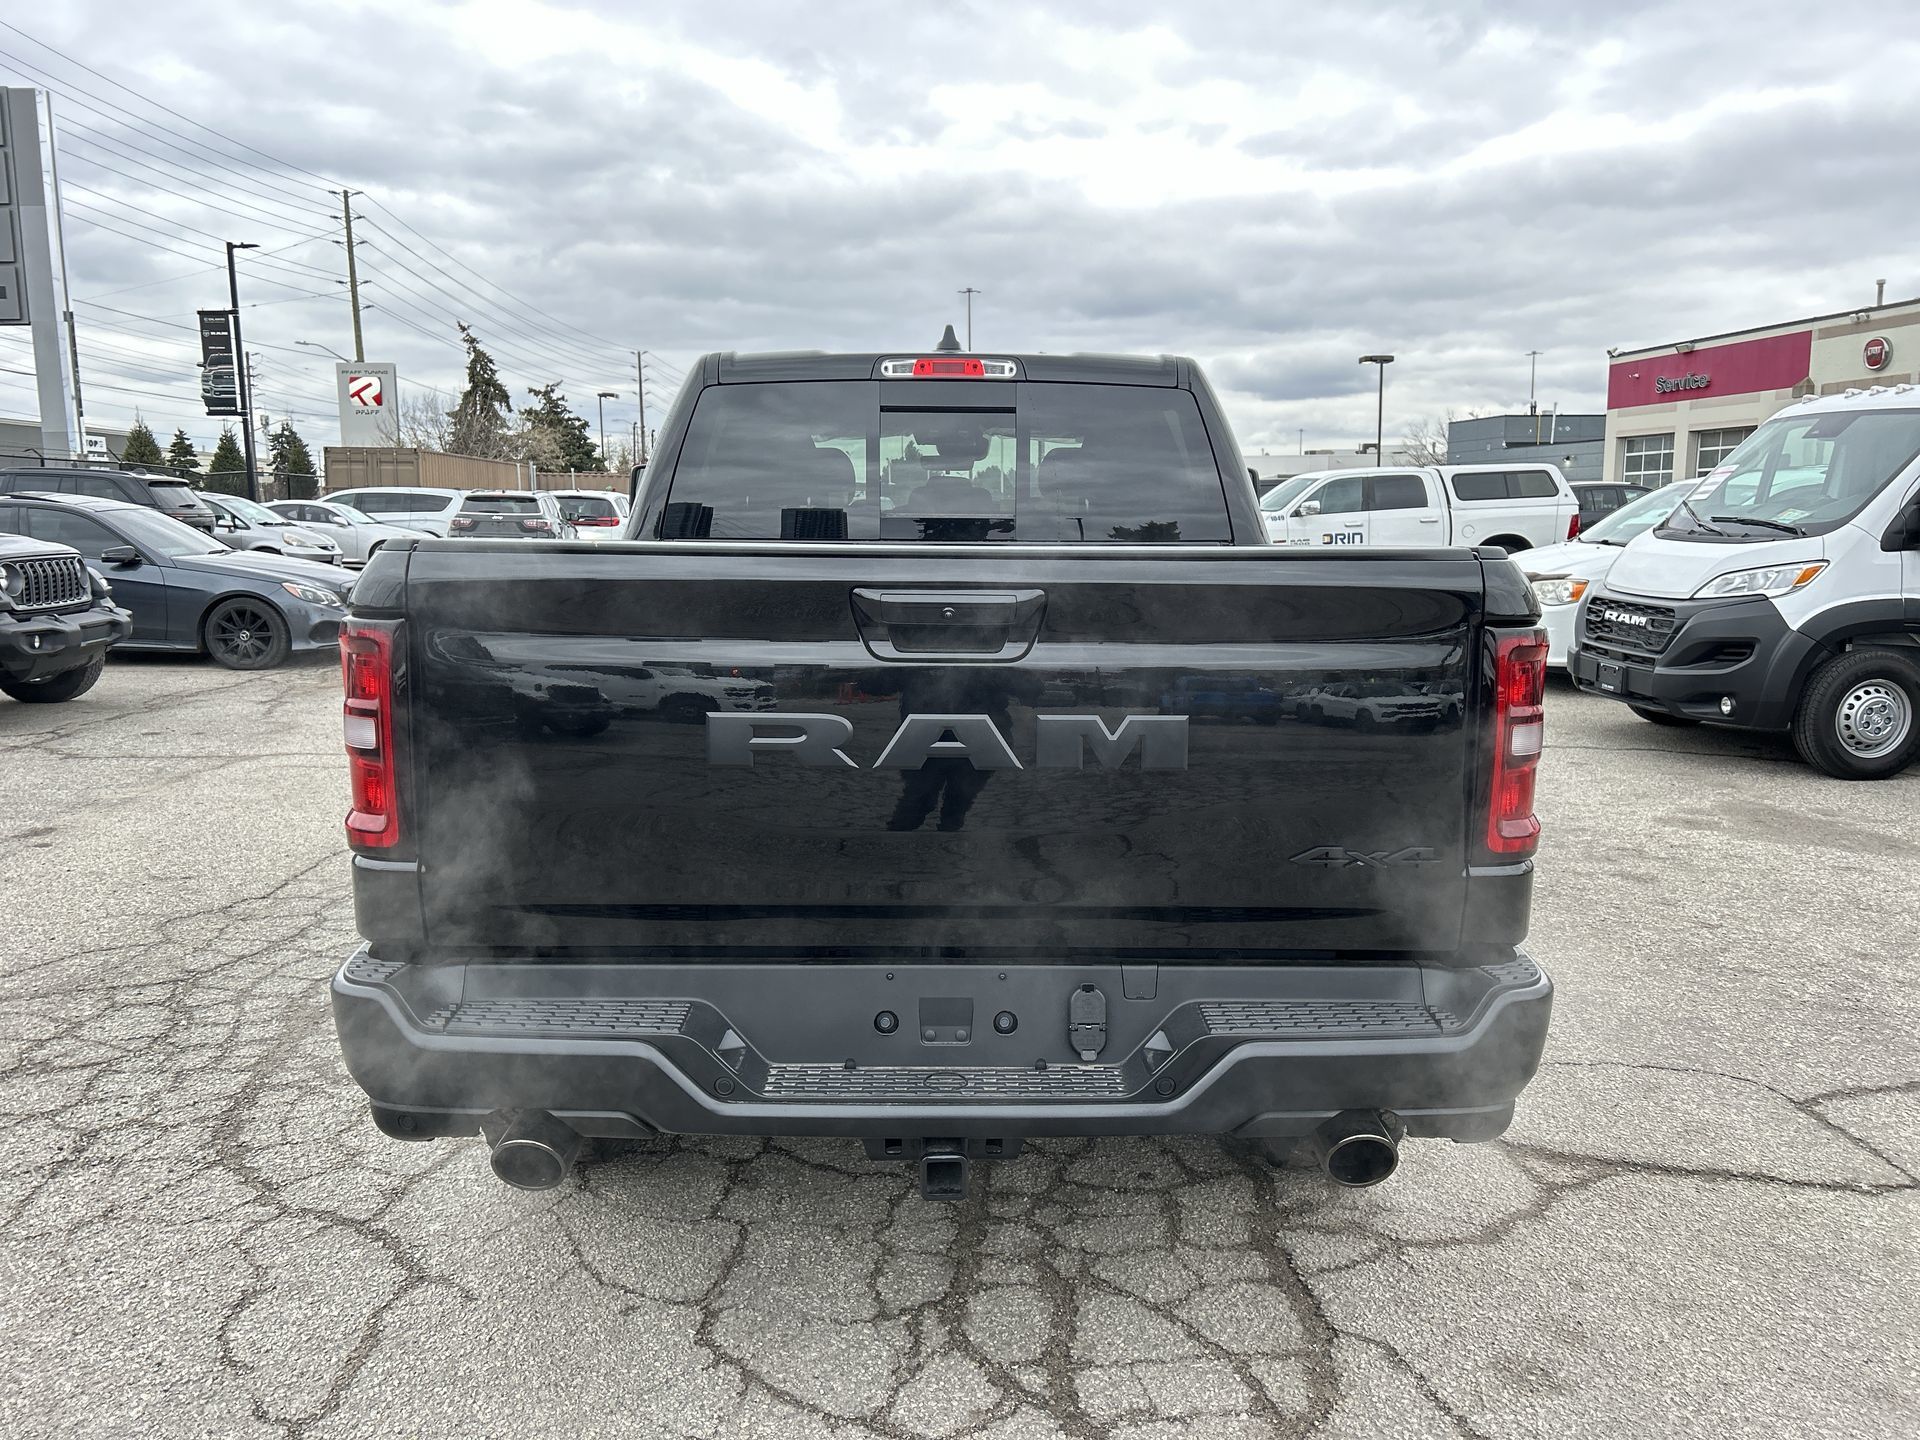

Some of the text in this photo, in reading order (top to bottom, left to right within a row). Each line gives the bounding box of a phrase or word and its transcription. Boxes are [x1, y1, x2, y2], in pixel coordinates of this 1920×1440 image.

[1655, 371, 1709, 393] Service
[1604, 610, 1647, 626] RAM
[706, 712, 1189, 770] RAM
